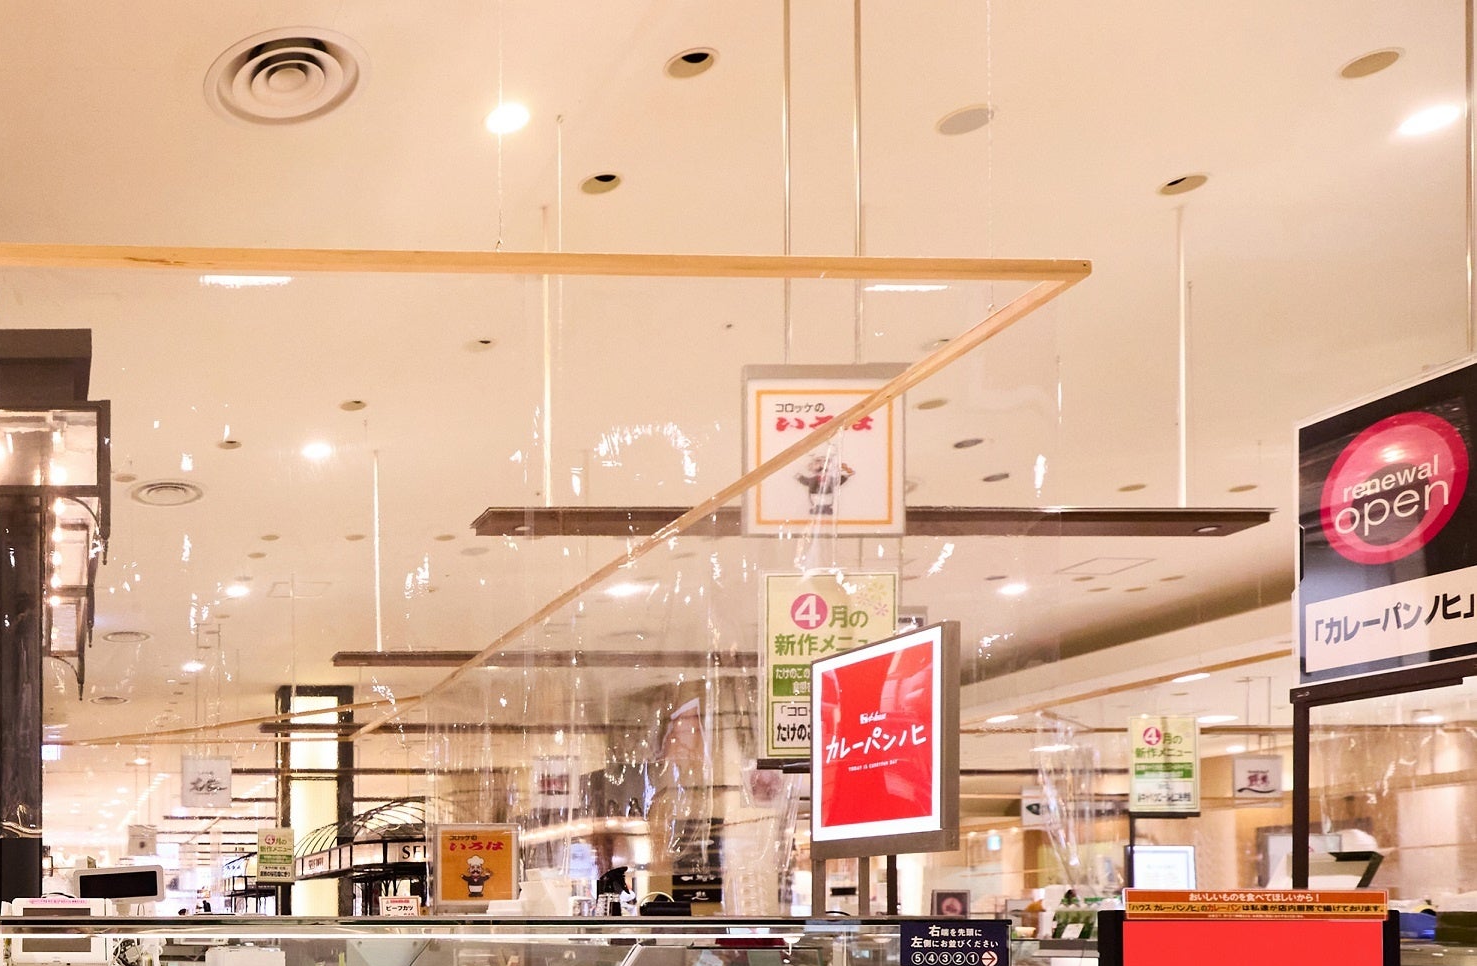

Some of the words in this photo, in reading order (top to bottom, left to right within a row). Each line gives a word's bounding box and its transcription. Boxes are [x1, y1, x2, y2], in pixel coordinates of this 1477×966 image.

[775, 403, 825, 413] コロッケの
[1343, 454, 1439, 502] renewal
[1335, 479, 1449, 536] open
[794, 595, 868, 628] 4月の
[1314, 593, 1475, 645] 「カレーパンノヒ」
[781, 705, 810, 717] 「コロ
[826, 724, 927, 764] カレーパンノヒ
[449, 841, 504, 851] いろは
[911, 936, 999, 948] 左側にお並びください
[929, 925, 982, 937] 右端を先頭に
